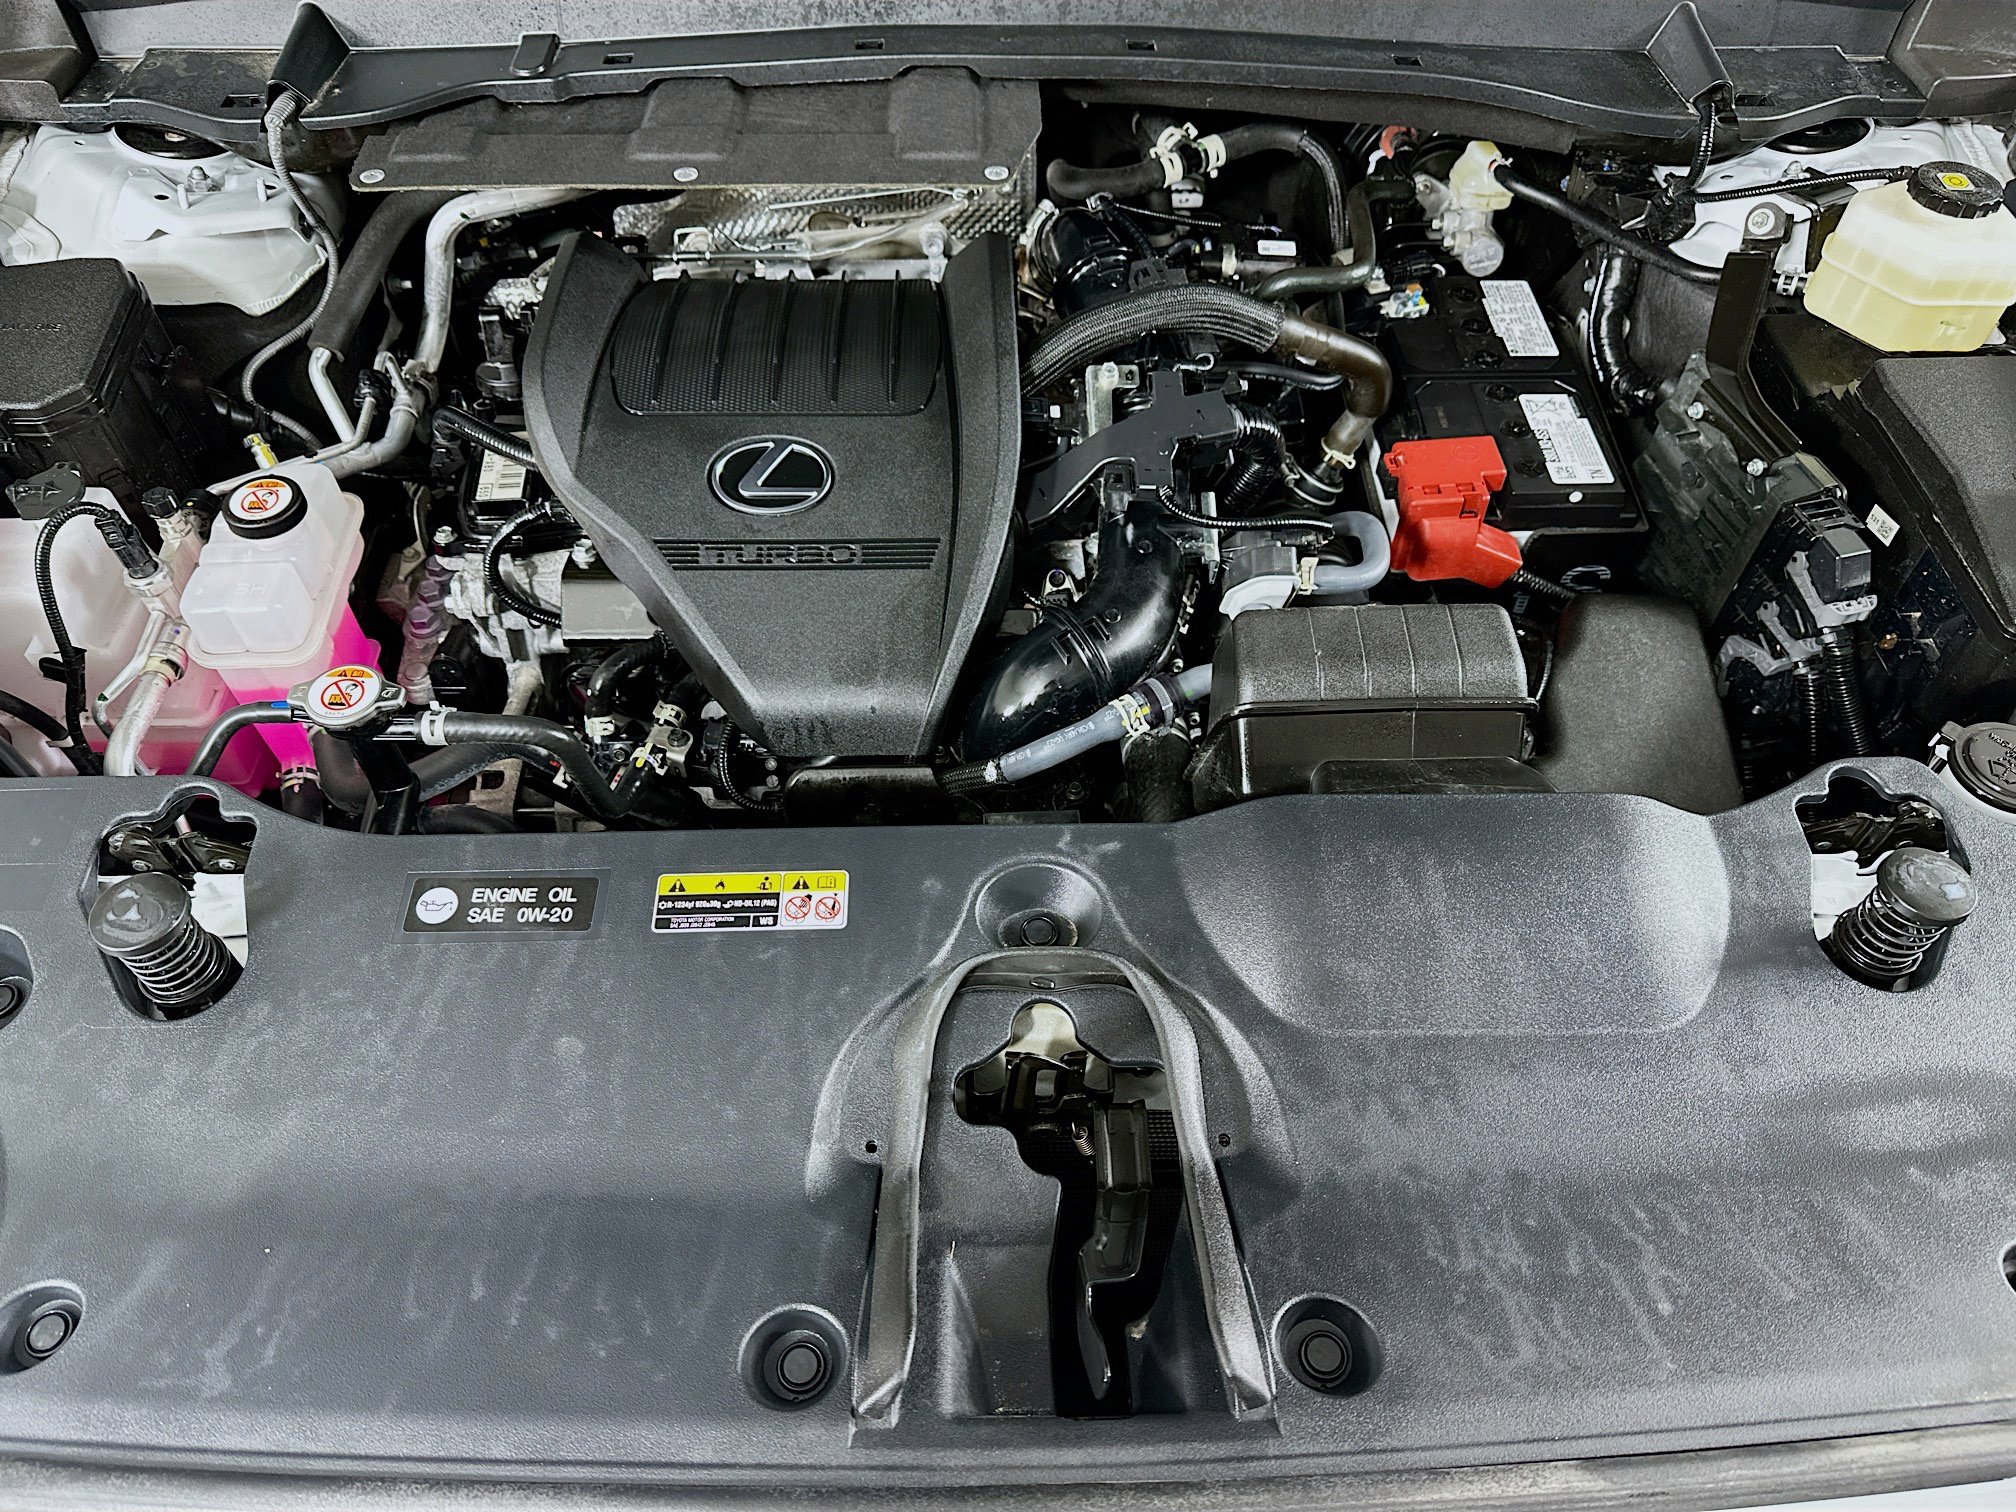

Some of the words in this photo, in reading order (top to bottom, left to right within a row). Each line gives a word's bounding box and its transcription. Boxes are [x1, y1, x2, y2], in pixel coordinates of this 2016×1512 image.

[704, 543, 857, 564] TURBO
[471, 887, 539, 903] ENGINE
[548, 887, 578, 903] OIL
[466, 907, 506, 923] SAE
[516, 907, 574, 923] 0W-20
[759, 916, 774, 926] WS
